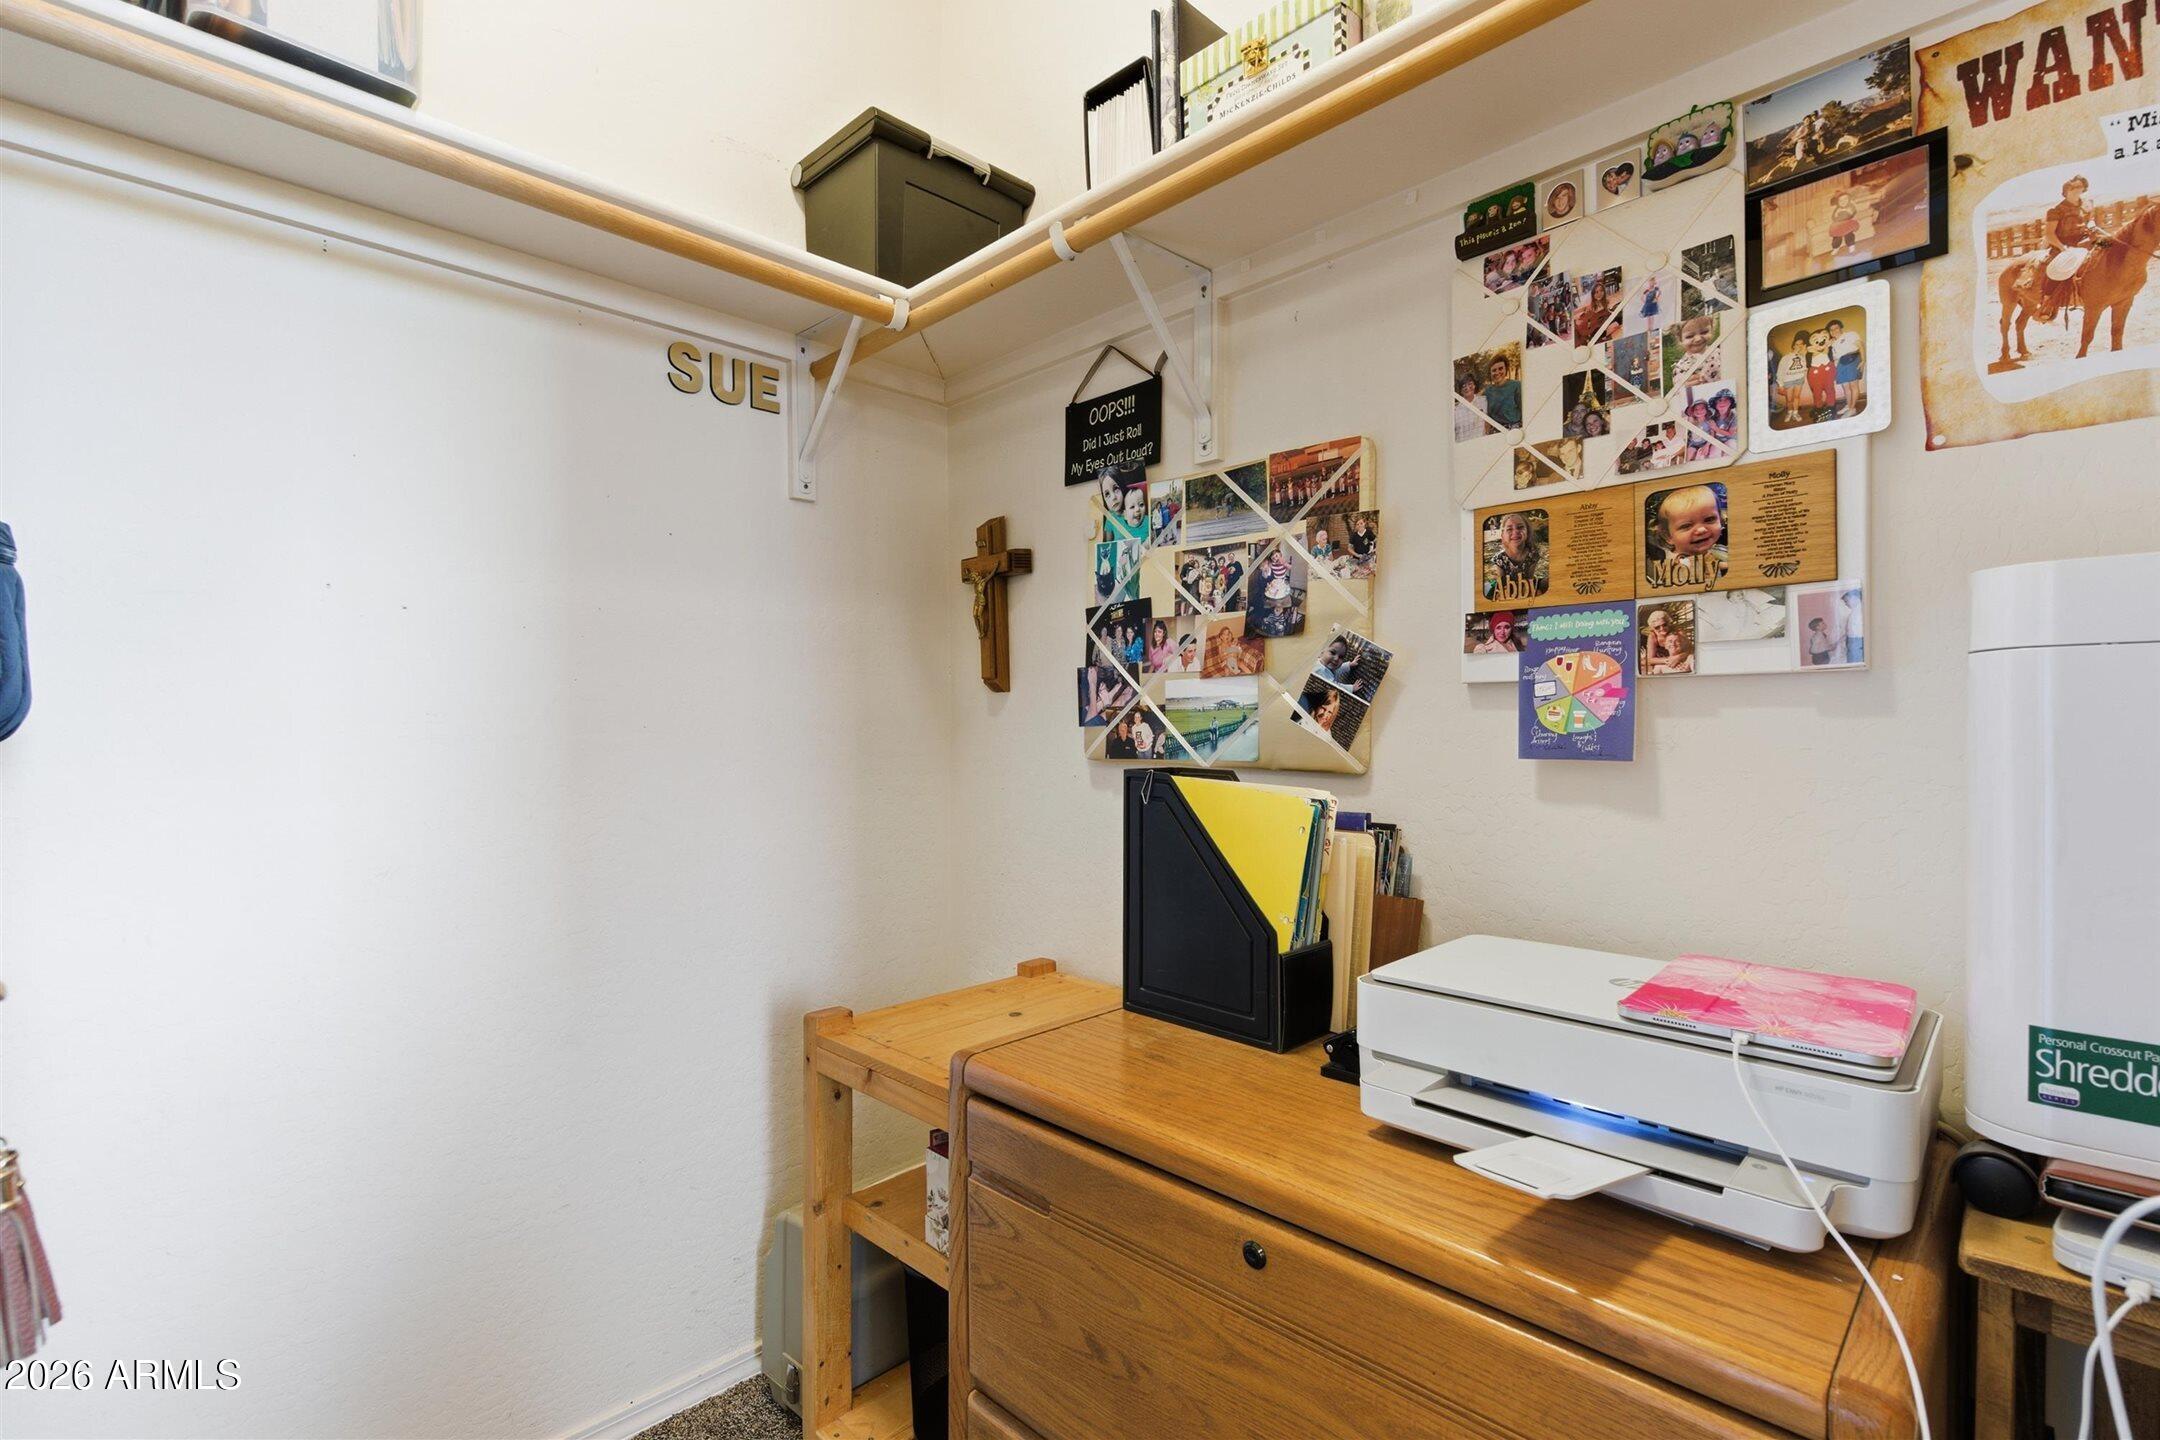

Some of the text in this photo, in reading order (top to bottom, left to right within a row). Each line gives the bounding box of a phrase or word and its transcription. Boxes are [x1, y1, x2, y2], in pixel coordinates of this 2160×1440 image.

[1957, 0, 2160, 128] WAN
[667, 341, 780, 414] SUE
[1089, 395, 1136, 426] OOPS!!!
[1082, 423, 1142, 452] Did I Just Roll
[1070, 442, 1154, 477] My Eyes Out Loud?
[1768, 470, 1791, 480] Molly
[1492, 572, 1539, 605] Abby
[1651, 552, 1722, 592] Molly
[2038, 1033, 2160, 1063] Personal Crosscut Pa
[2035, 1048, 2160, 1098] Shredd
